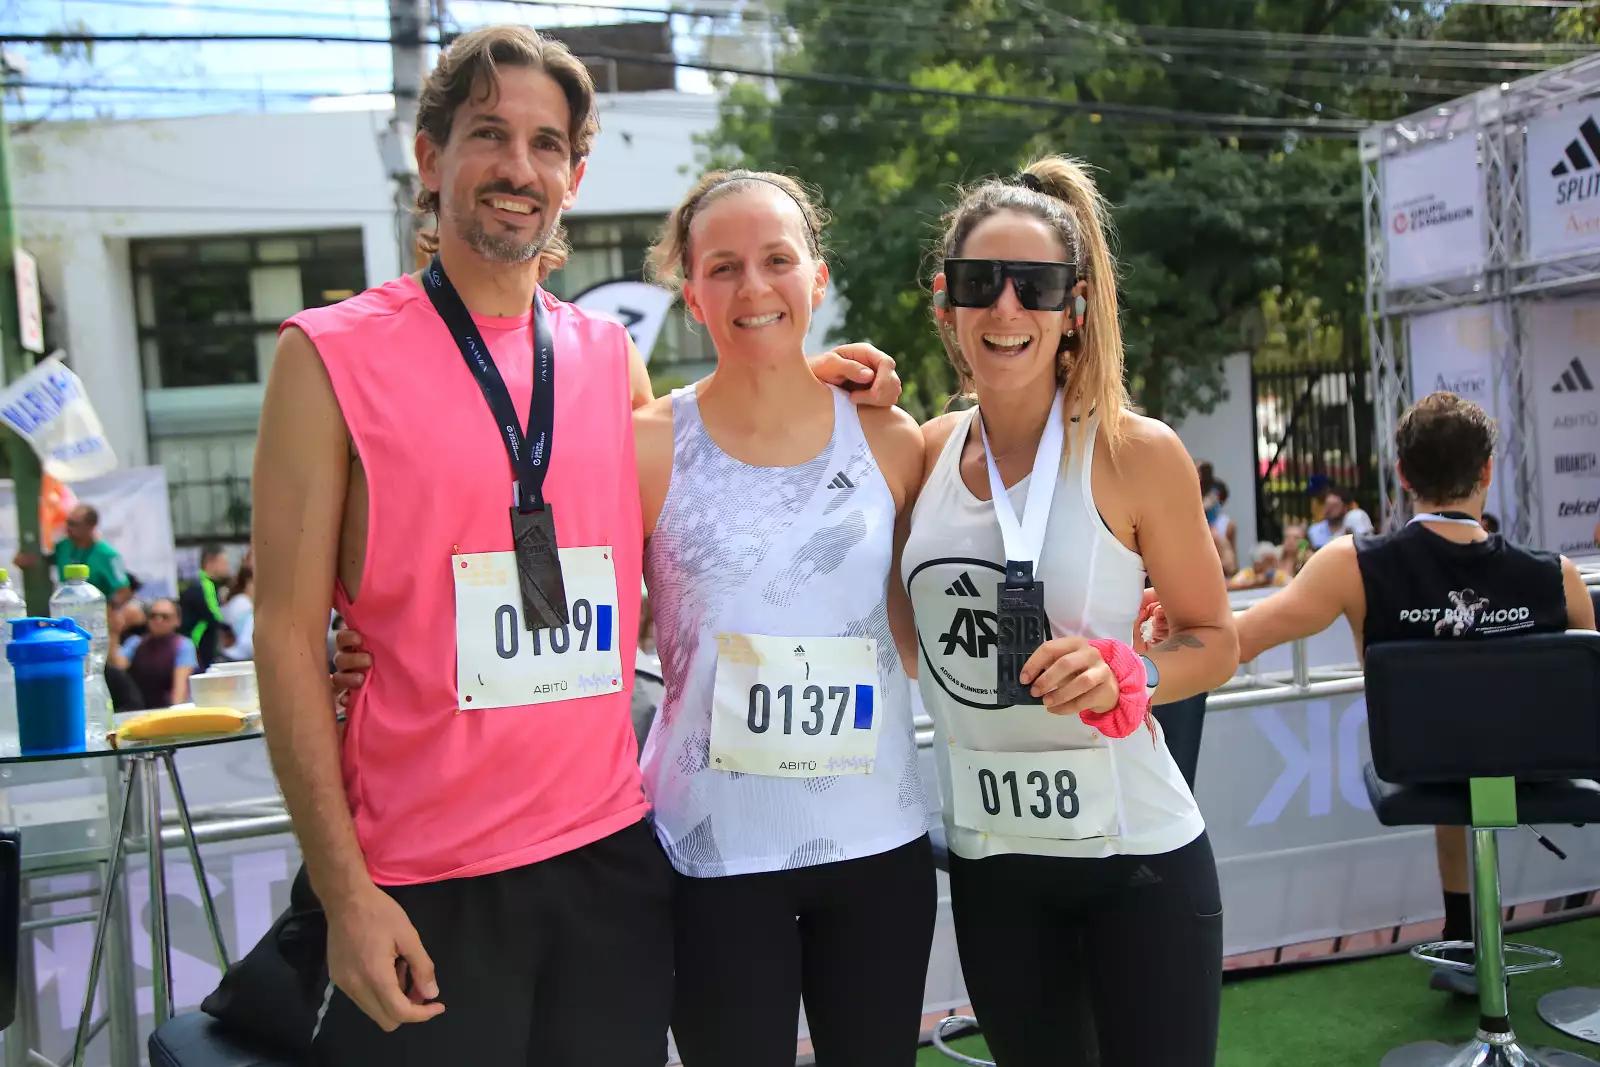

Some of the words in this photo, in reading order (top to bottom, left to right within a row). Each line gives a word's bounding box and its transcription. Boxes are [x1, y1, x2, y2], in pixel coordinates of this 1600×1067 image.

[1400, 608, 1441, 622] POST
[1480, 606, 1530, 624] MOOD
[533, 680, 568, 694] ABITÜ
[940, 666, 960, 686] ADIDAS
[960, 682, 989, 695] RUNNERS
[747, 683, 851, 736] 0137
[778, 761, 817, 771] ABITÜ
[978, 768, 1080, 819] 0138
